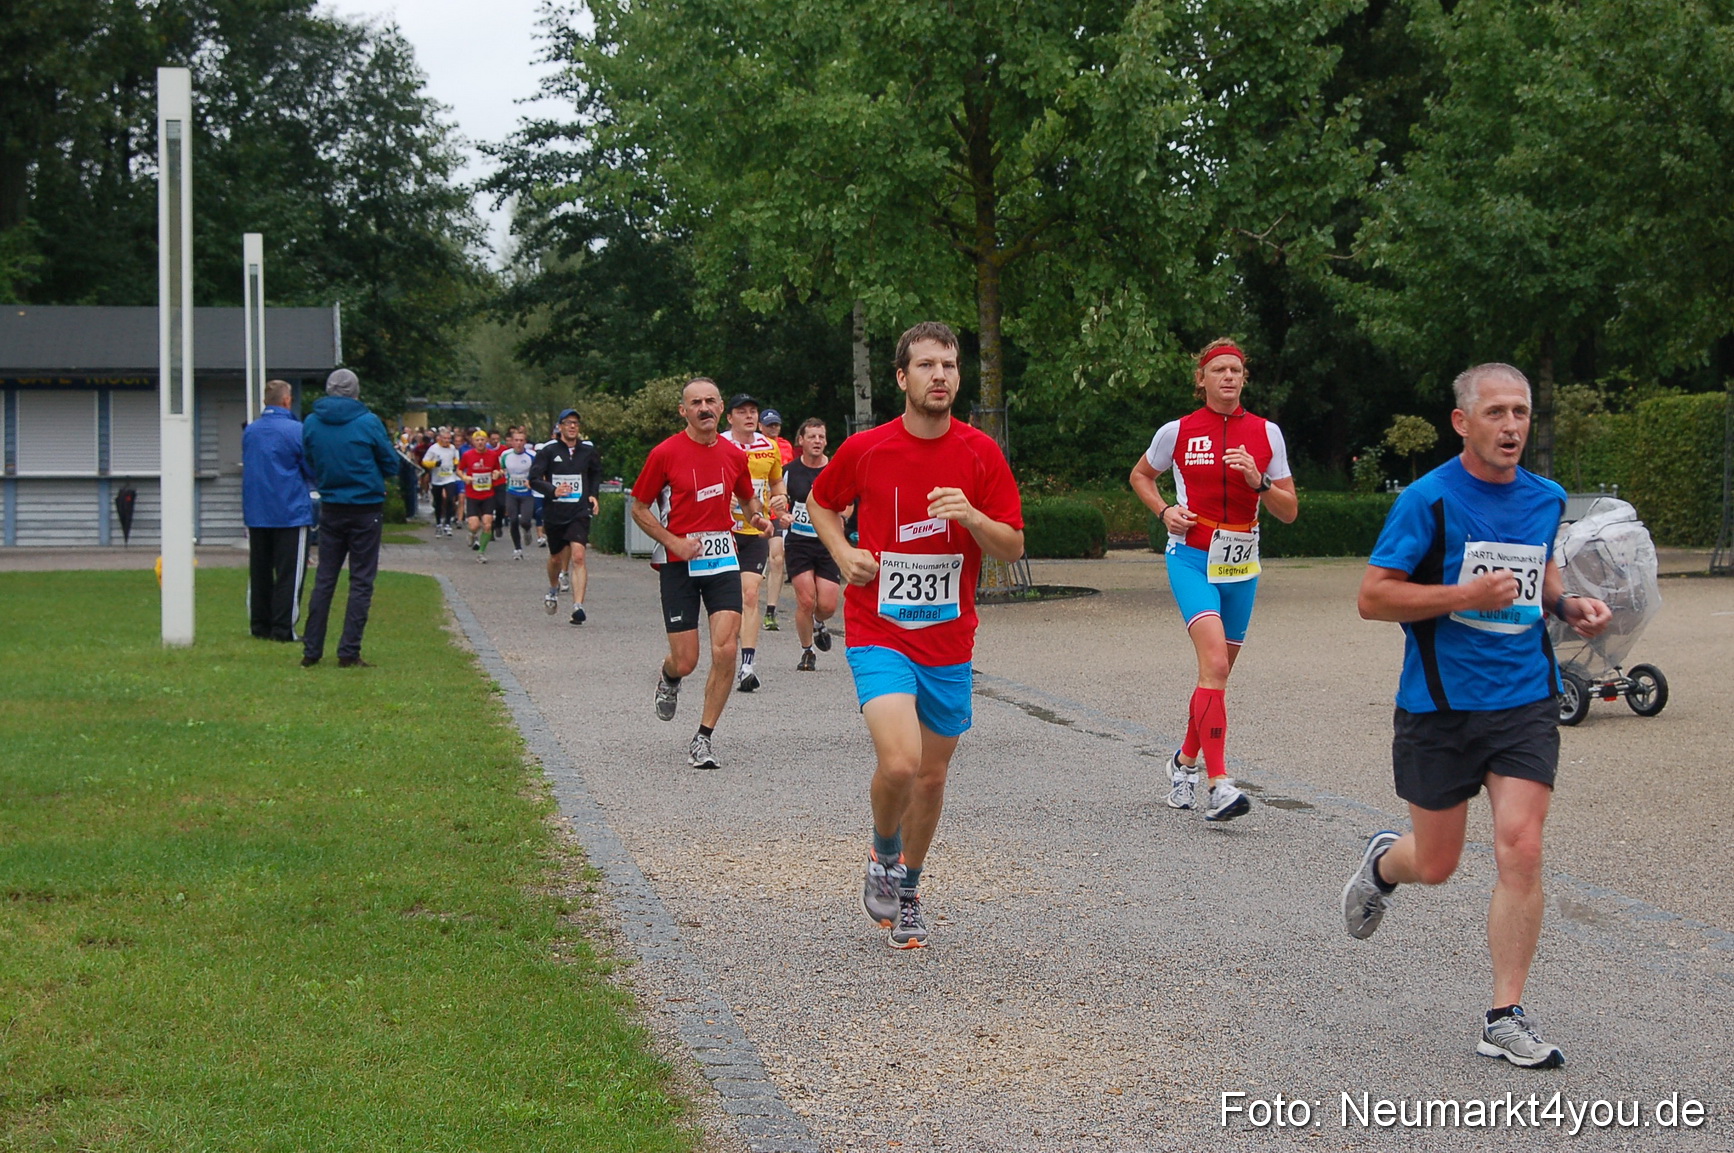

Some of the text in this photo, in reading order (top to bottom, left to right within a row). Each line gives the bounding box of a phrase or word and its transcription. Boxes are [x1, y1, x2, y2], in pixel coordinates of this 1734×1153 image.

[912, 523, 934, 535] DEHN
[1222, 544, 1254, 564] 134
[882, 559, 949, 570] PARTL Neumarkt
[888, 571, 951, 602] 2331
[898, 607, 942, 621] Raphael
